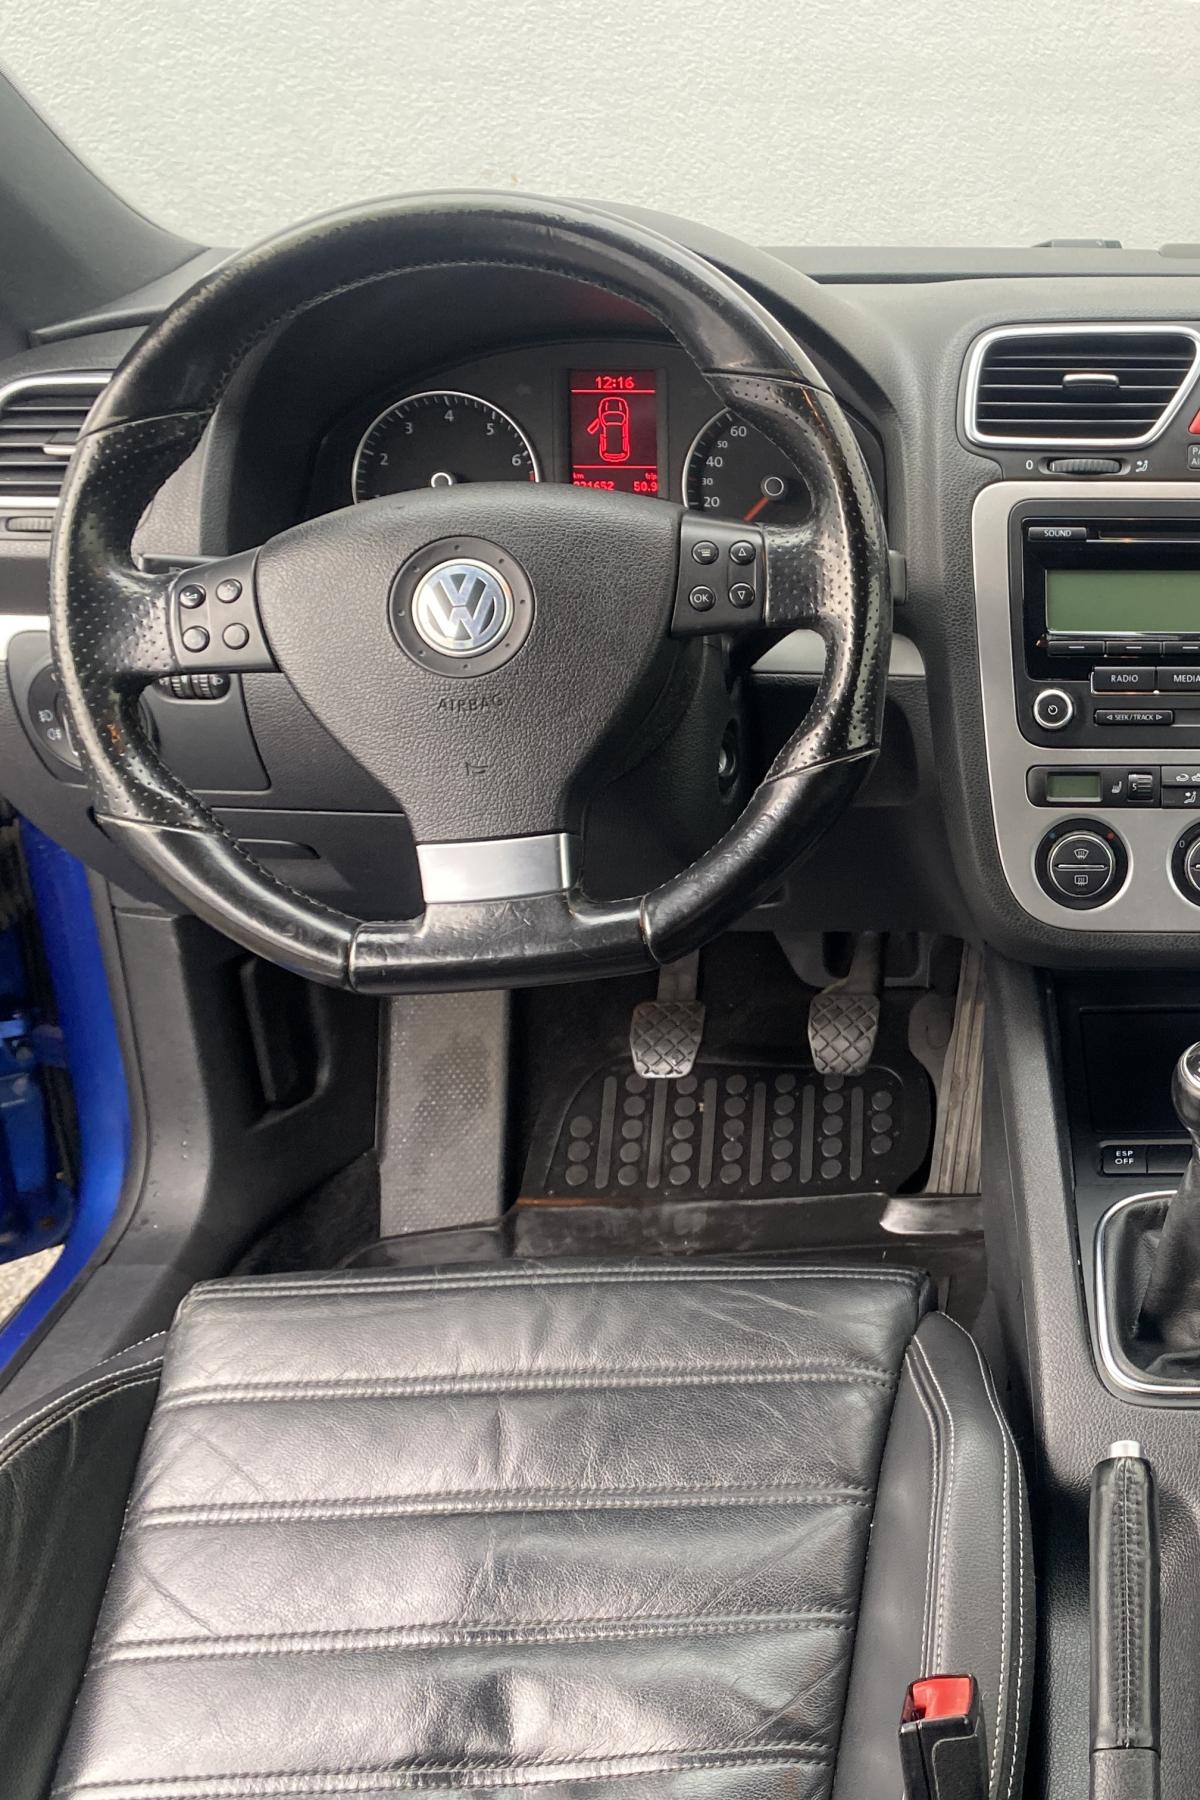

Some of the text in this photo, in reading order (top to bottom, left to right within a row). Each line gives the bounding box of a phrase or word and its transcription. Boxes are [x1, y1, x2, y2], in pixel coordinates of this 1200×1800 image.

[595, 376, 635, 389] 12:16
[444, 409, 454, 422] 4
[405, 422, 413, 435] 3
[486, 422, 494, 436] 5
[730, 426, 747, 437] 60
[717, 440, 728, 449] 50
[379, 453, 389, 466] 2
[511, 455, 521, 466] 6
[706, 456, 723, 468] 40
[1025, 459, 1034, 470] 0
[645, 472, 657, 480] trip
[633, 481, 658, 492] 50.9
[702, 478, 713, 486] 30
[703, 497, 720, 508] 20
[1044, 529, 1072, 537] SOUND
[693, 593, 709, 603] OK
[1110, 674, 1139, 683] RADIO
[437, 691, 503, 712] AIRBAG
[1179, 840, 1185, 848] 0
